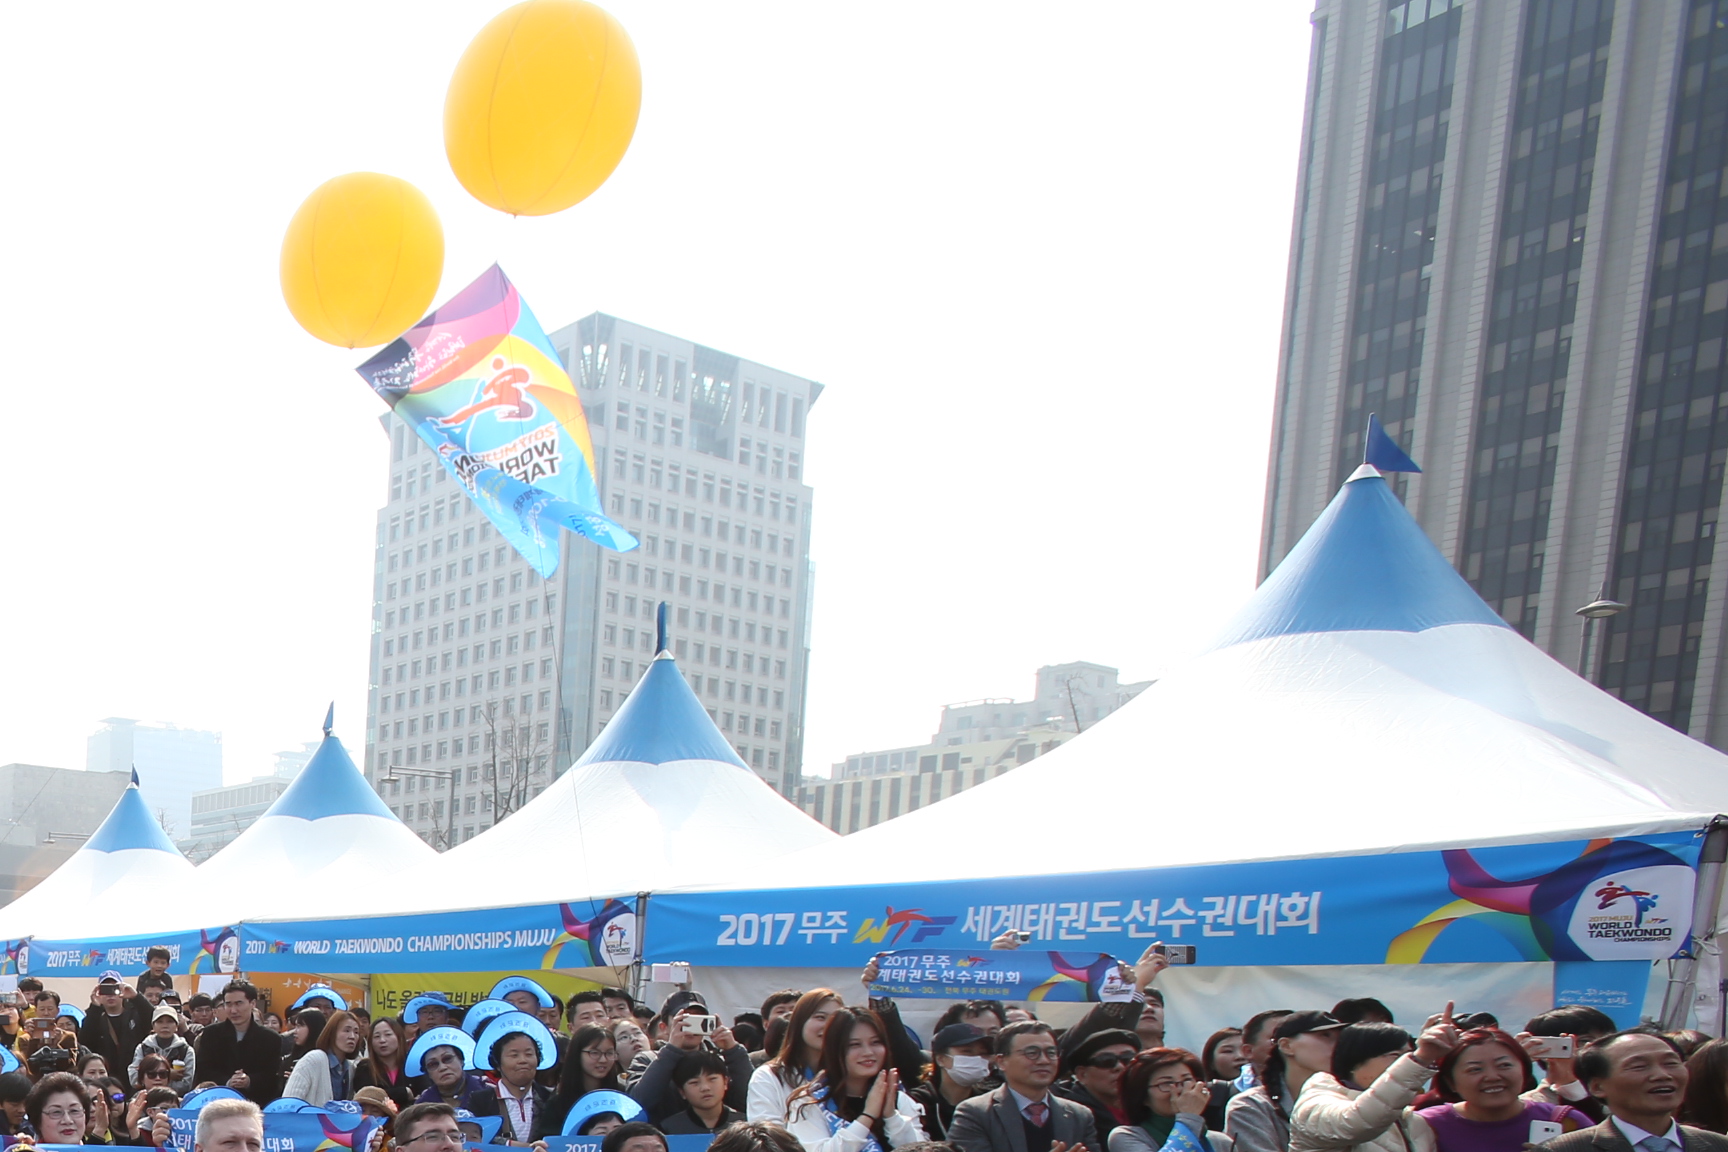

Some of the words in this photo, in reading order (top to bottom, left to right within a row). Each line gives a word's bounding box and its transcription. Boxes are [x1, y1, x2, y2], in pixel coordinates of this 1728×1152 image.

[717, 913, 795, 946] 2017
[798, 910, 848, 944] 무주
[852, 905, 959, 946] WTF
[960, 891, 1321, 942] 세계태권도선수권대회
[1588, 921, 1633, 930] WORLD
[245, 941, 266, 954] 2017
[294, 940, 331, 954] WORLD
[334, 937, 403, 954] TAEKWONDO
[407, 930, 512, 953] CHAMPIONSHIPS
[514, 928, 557, 948] MUJU
[1587, 928, 1672, 938] TAEKWONDO
[46, 951, 68, 967] 2017
[68, 950, 81, 966] 무주
[884, 955, 918, 967] 2017
[921, 955, 951, 968] 무주
[376, 989, 398, 1010] 나도
